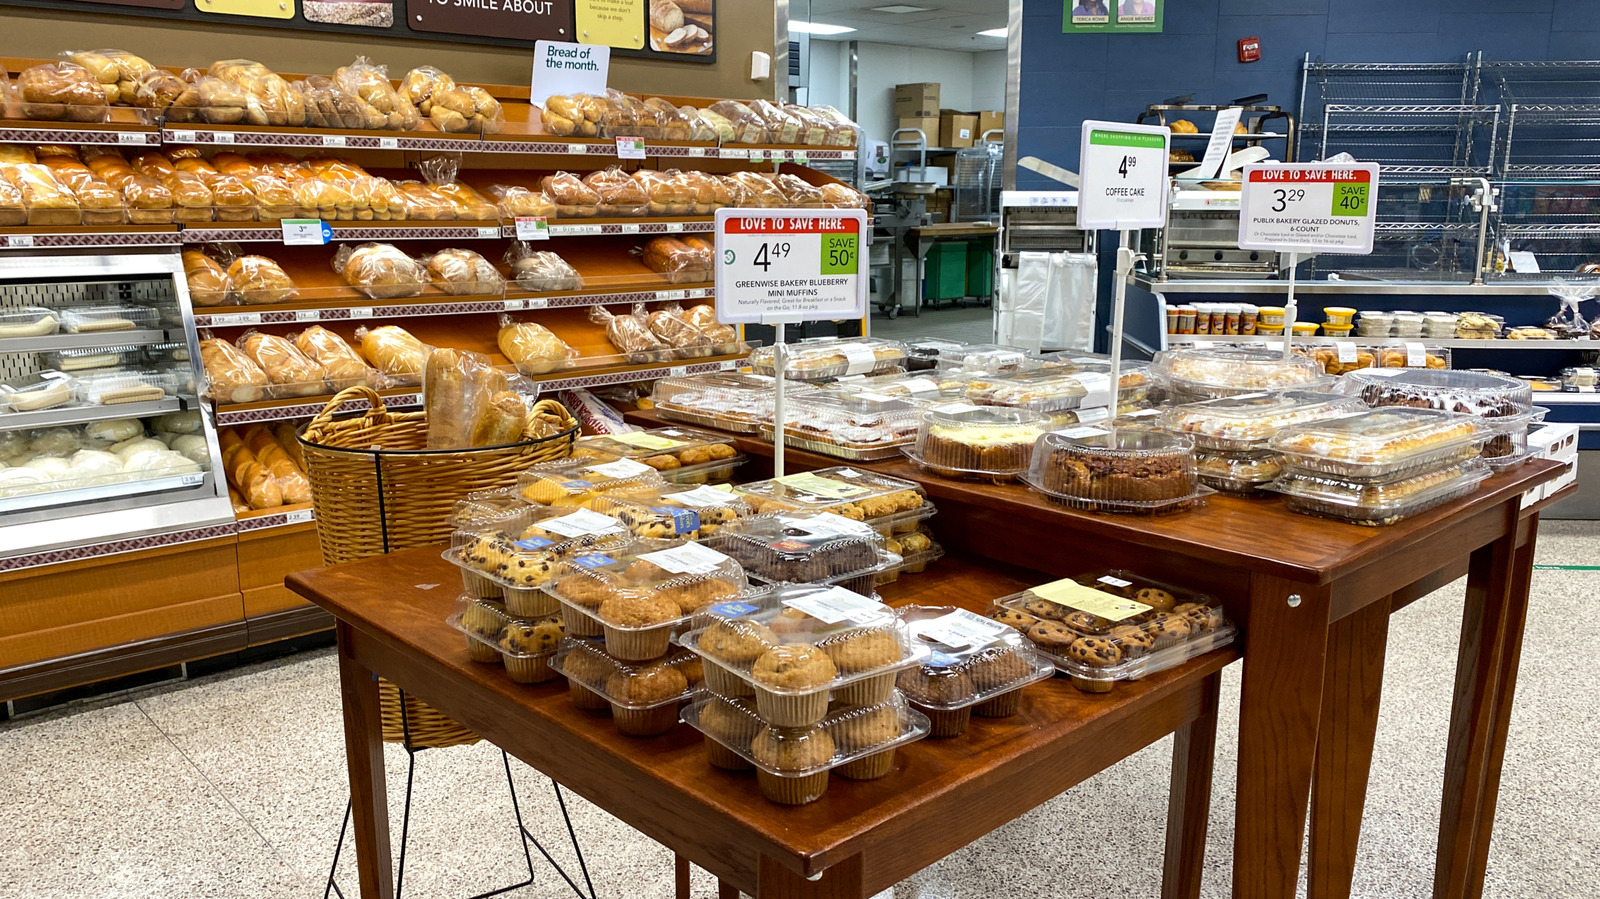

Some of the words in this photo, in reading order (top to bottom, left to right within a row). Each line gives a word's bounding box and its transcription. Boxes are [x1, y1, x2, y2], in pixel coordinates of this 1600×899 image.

[502, 0, 554, 15] ABOUT
[547, 46, 577, 58] Bread
[579, 47, 592, 59] of
[546, 58, 562, 68] the
[564, 59, 600, 71] month.
[1262, 170, 1285, 179] LOVE
[1289, 170, 1301, 179] TO
[1305, 170, 1327, 179] SAVE
[1331, 170, 1357, 180] HERE.
[1105, 187, 1129, 196] COFFEE
[1129, 188, 1145, 196] CAKE
[1341, 186, 1366, 195] SAVE
[740, 218, 766, 230] LOVE
[772, 218, 785, 230] TO
[790, 218, 814, 230] SAVE
[819, 218, 846, 230] HERE.
[829, 238, 855, 249] SAVE
[735, 280, 779, 288] GREENWISE
[780, 279, 809, 287] BAKERY
[809, 278, 849, 287] BLUEBERRY
[768, 289, 785, 297] MINI
[786, 289, 818, 297] MUFFINS
